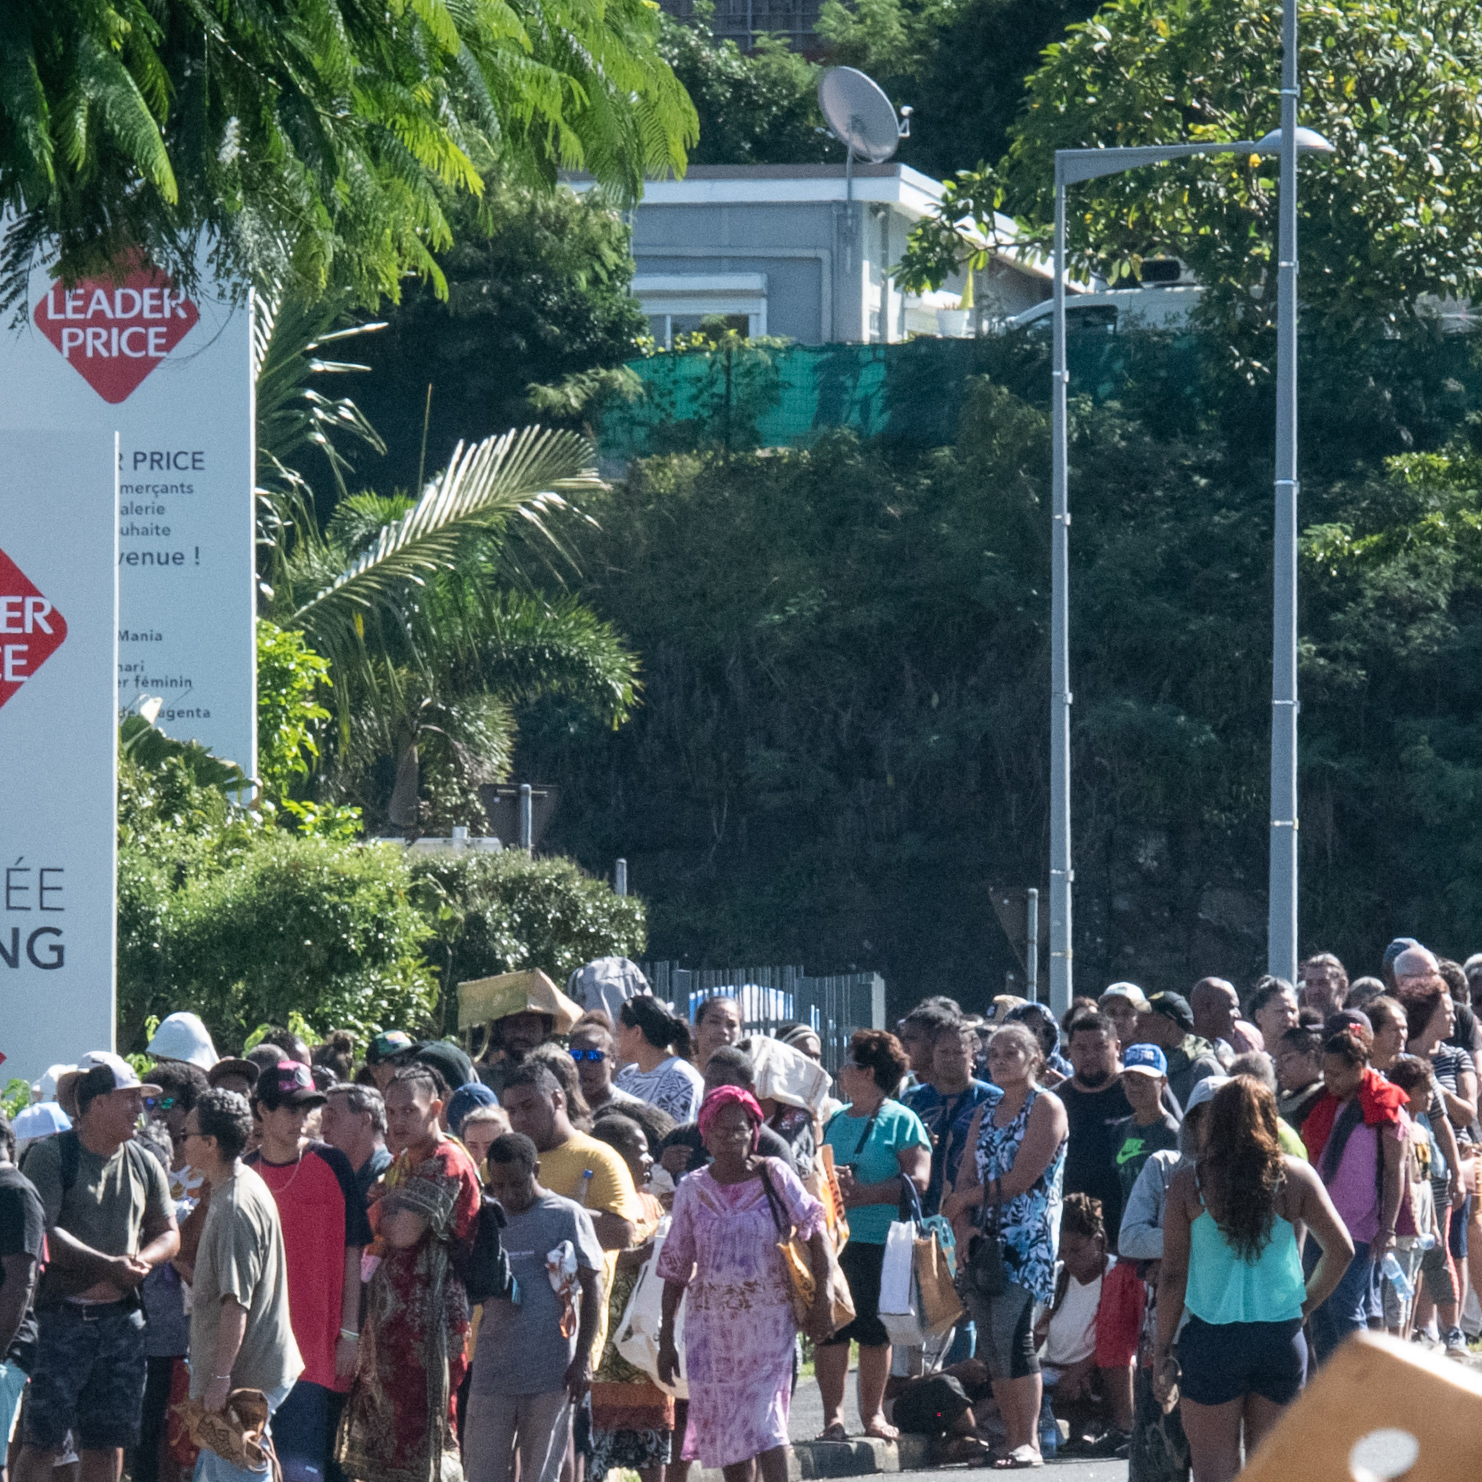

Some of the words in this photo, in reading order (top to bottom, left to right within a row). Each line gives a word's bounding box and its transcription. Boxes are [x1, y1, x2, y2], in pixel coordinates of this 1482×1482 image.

[46, 286, 188, 320] LEADER
[61, 326, 169, 358] PRICE
[133, 451, 204, 470] PRICE
[195, 546, 200, 565] !
[135, 676, 192, 687] féminin
